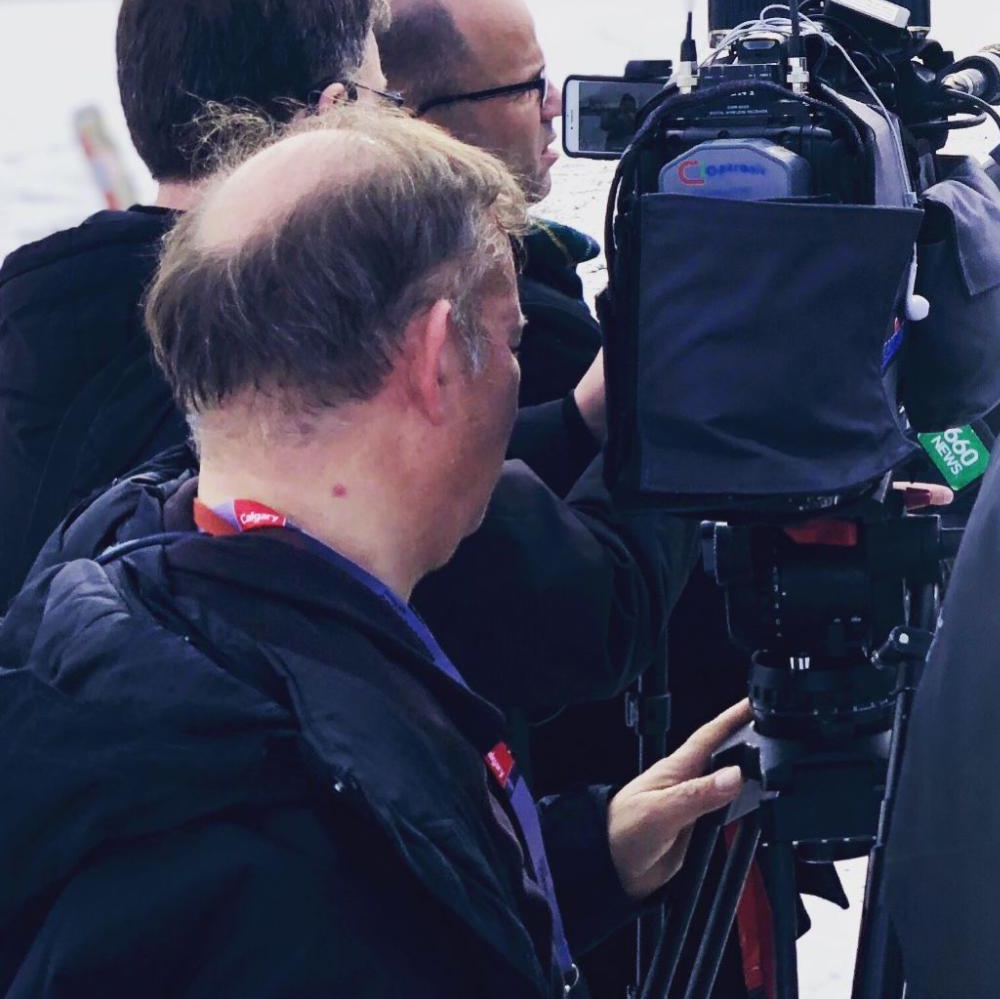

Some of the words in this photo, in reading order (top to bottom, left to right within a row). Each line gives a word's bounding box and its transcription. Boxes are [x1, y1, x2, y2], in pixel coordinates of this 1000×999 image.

[930, 434, 964, 476] NEWS
[943, 427, 979, 467] 660
[240, 511, 279, 525] Calgary
